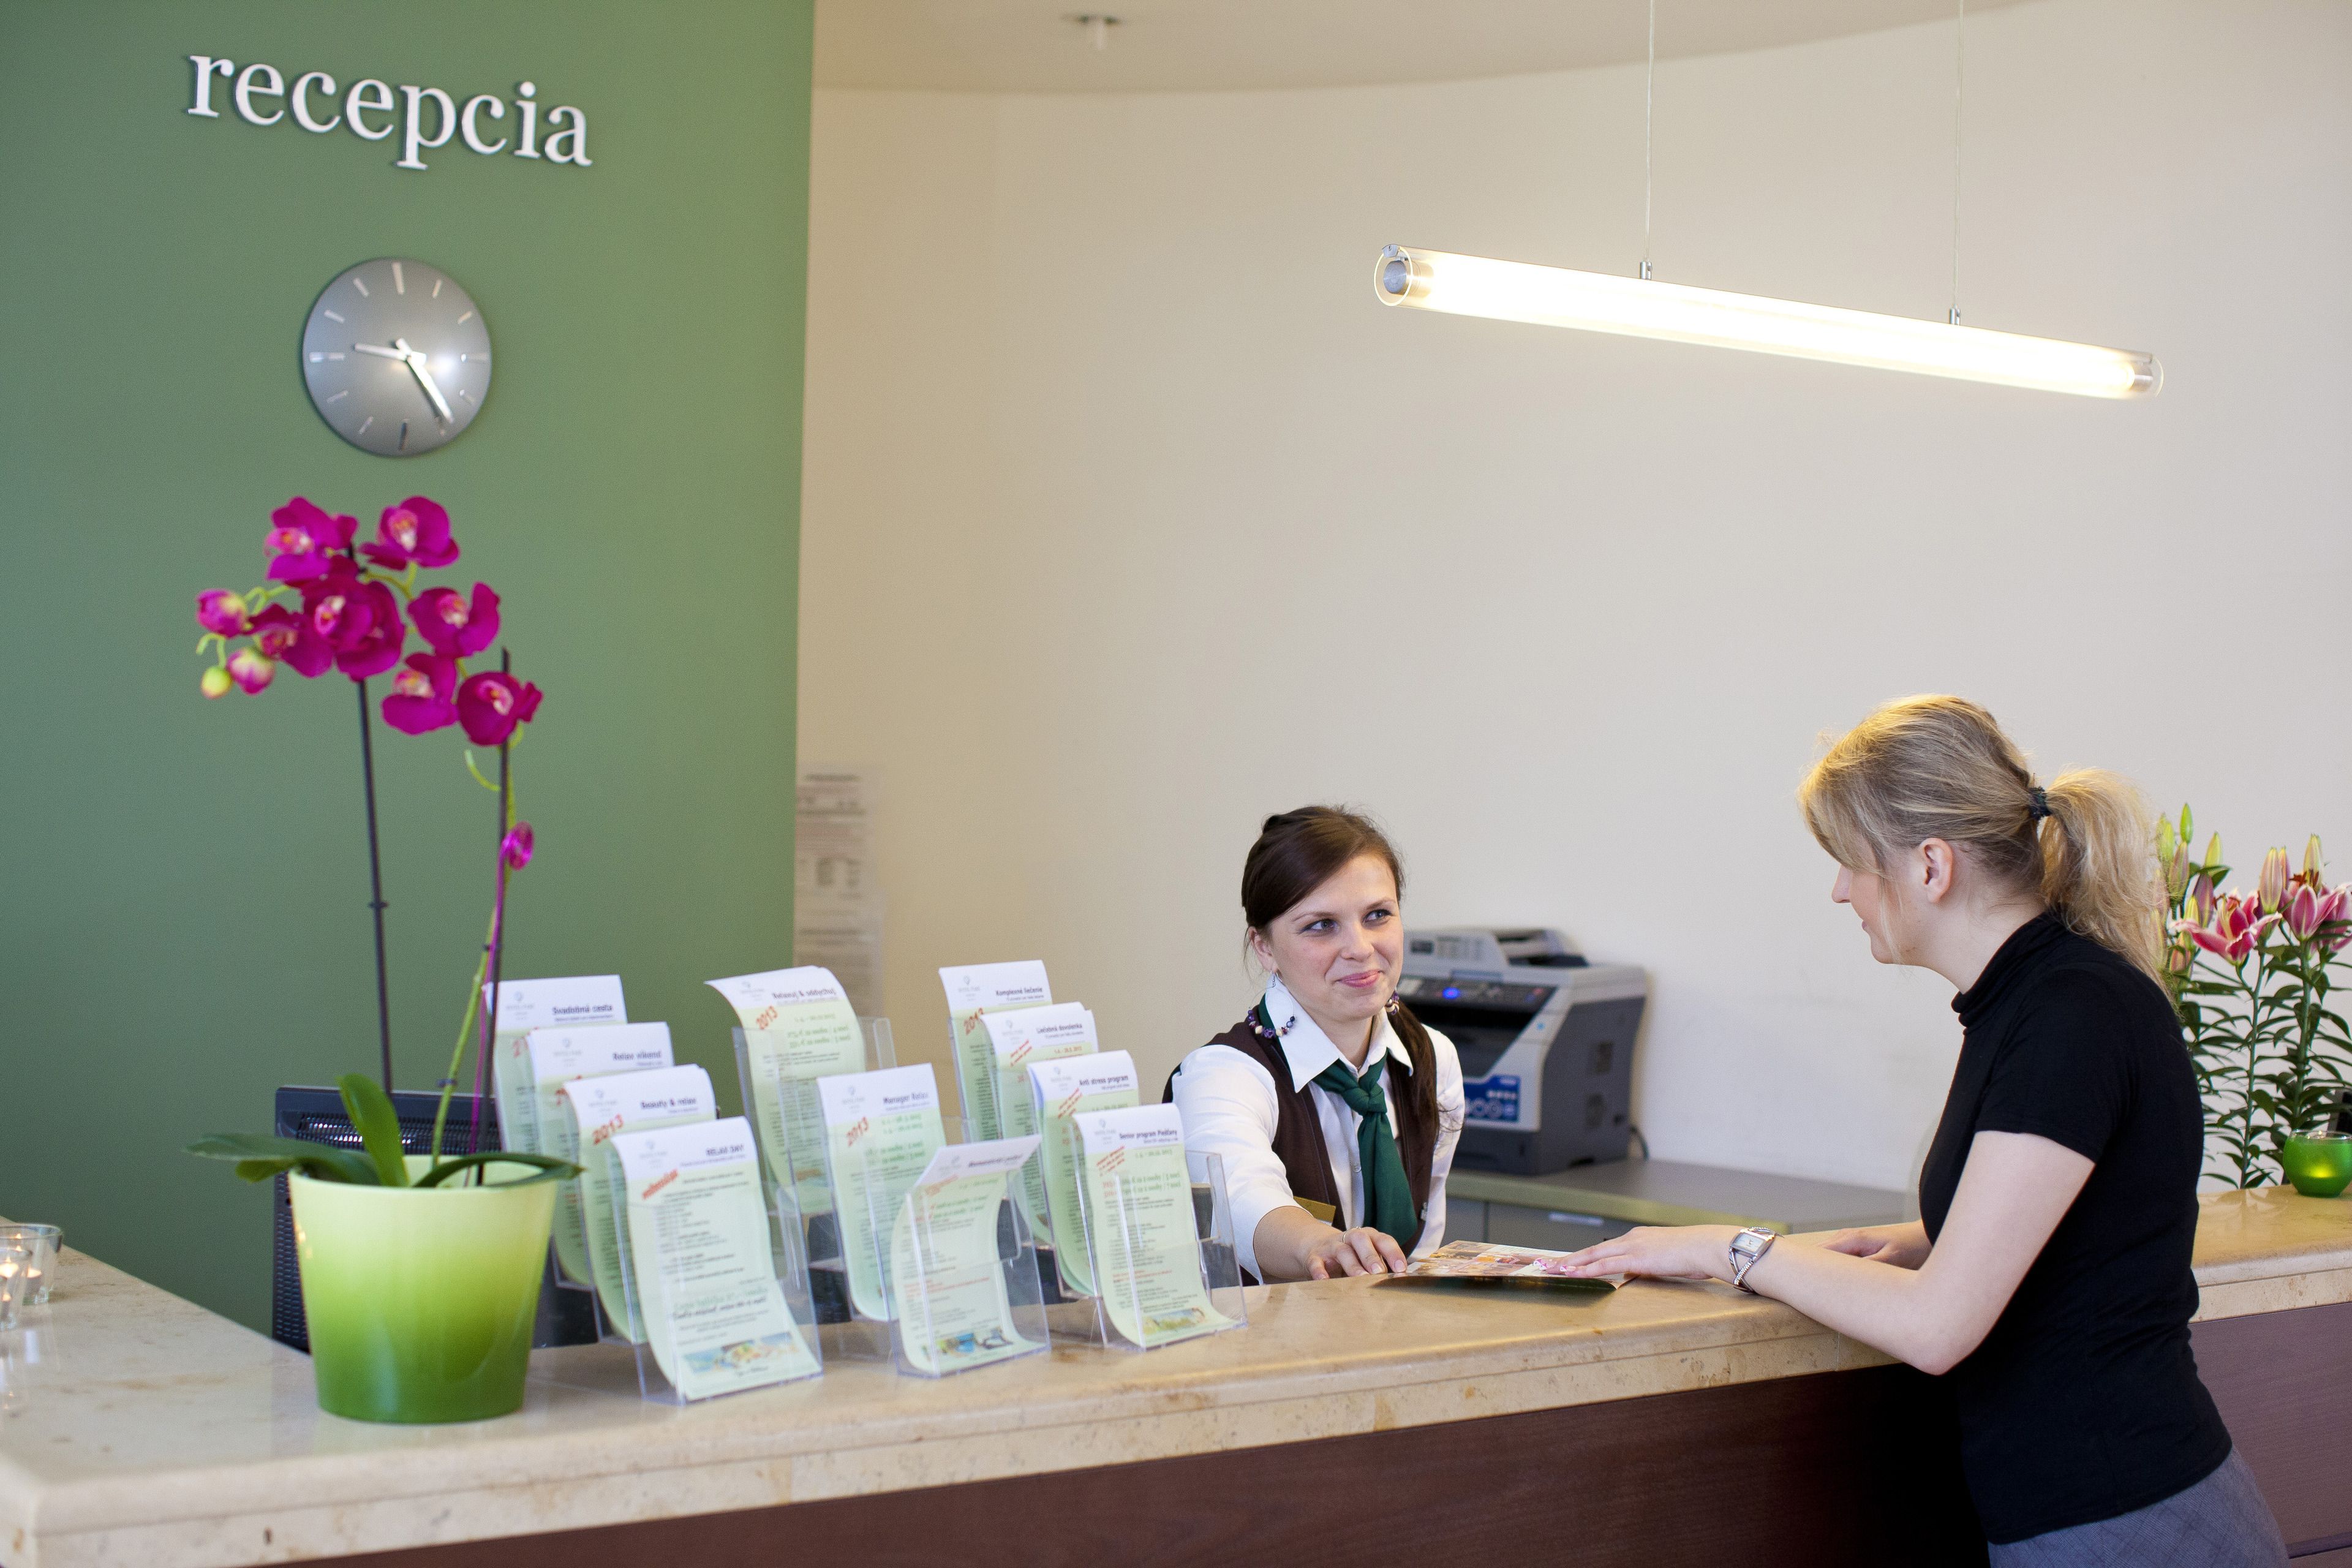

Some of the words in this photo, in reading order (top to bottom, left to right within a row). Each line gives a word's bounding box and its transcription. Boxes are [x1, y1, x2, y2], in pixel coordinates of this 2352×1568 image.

[187, 55, 593, 170] recepcia
[552, 1003, 589, 1015] Svadobná
[592, 1004, 613, 1012] cesta
[756, 1005, 778, 1030] 2013
[613, 1052, 635, 1061] Relax
[1107, 1075, 1128, 1084] program
[883, 1094, 910, 1104] Manager
[911, 1091, 929, 1100] Relax
[641, 1099, 667, 1110] Beauty
[592, 1114, 624, 1146] 2013
[846, 1116, 869, 1147] 2013
[1136, 1131, 1156, 1139] program
[706, 1146, 728, 1156] RELAX
[729, 1144, 745, 1153] DAY
